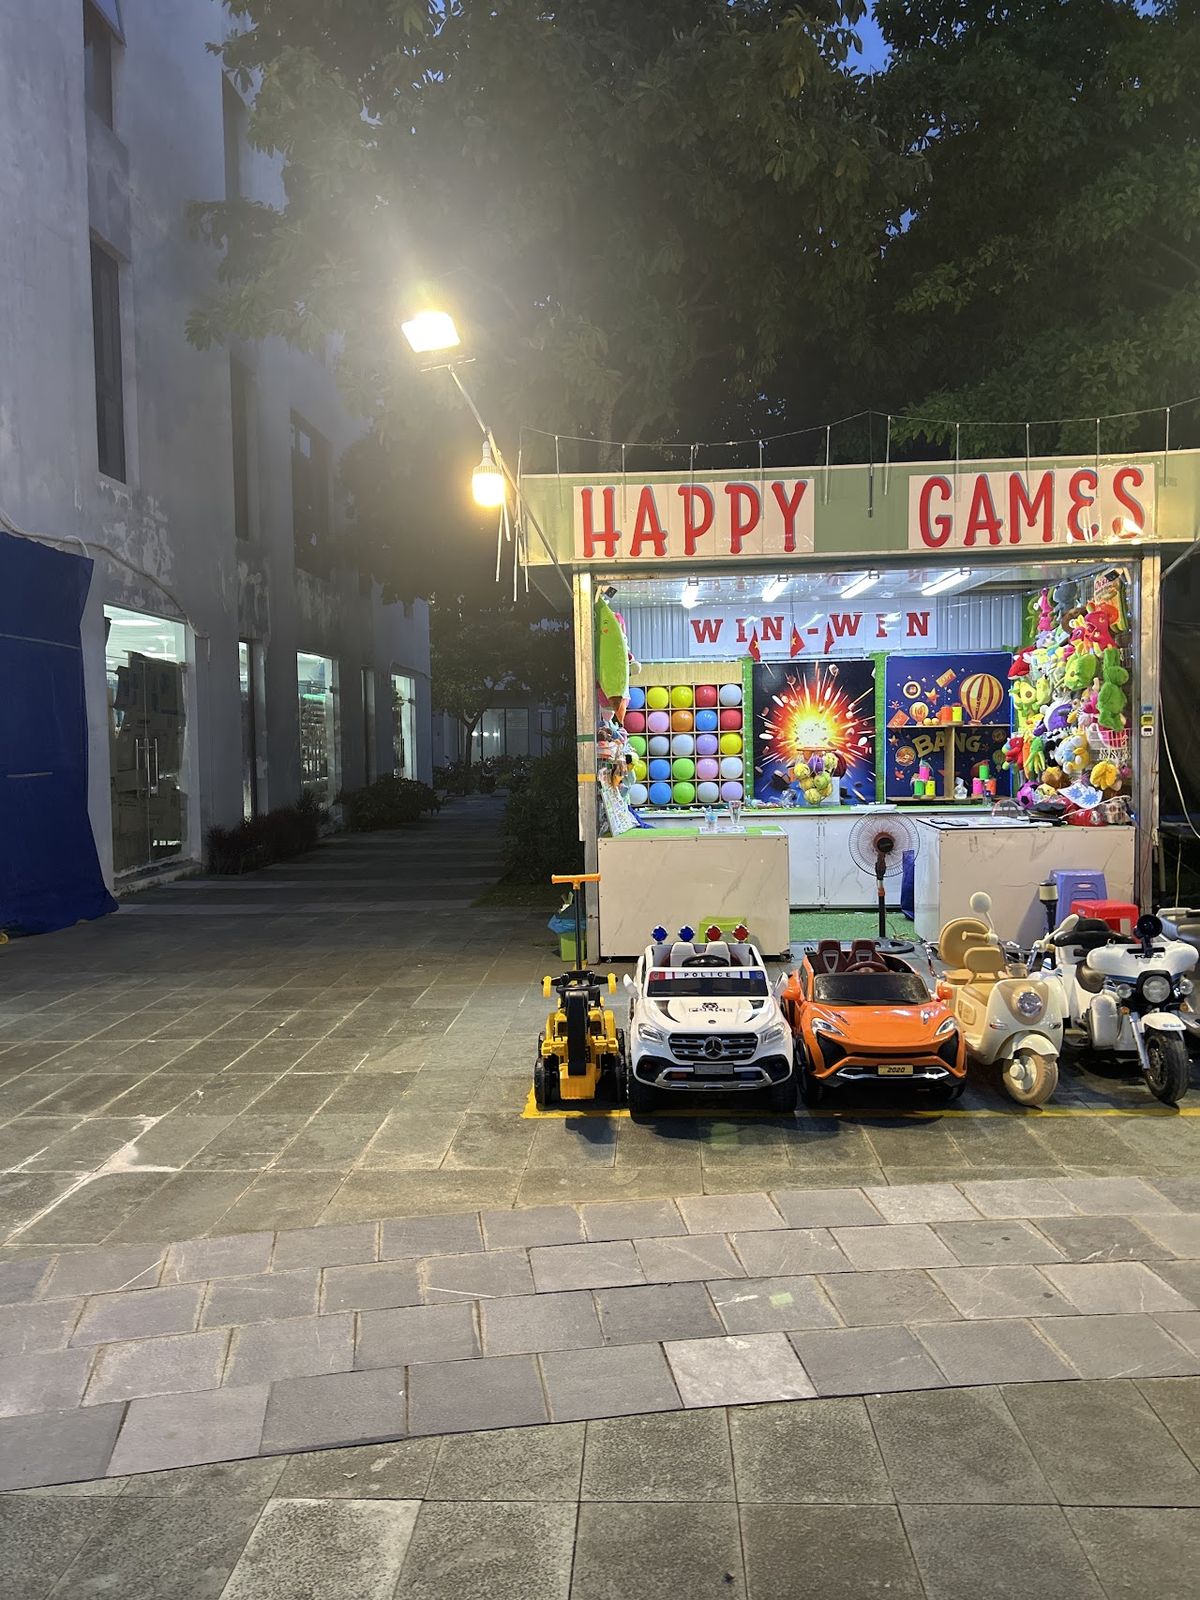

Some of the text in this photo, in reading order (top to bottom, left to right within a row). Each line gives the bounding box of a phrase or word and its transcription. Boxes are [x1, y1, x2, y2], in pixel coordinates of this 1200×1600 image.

[581, 467, 1146, 558] HAPPY GAMES
[911, 730, 982, 758] BANG
[886, 1066, 906, 1074] 2020
